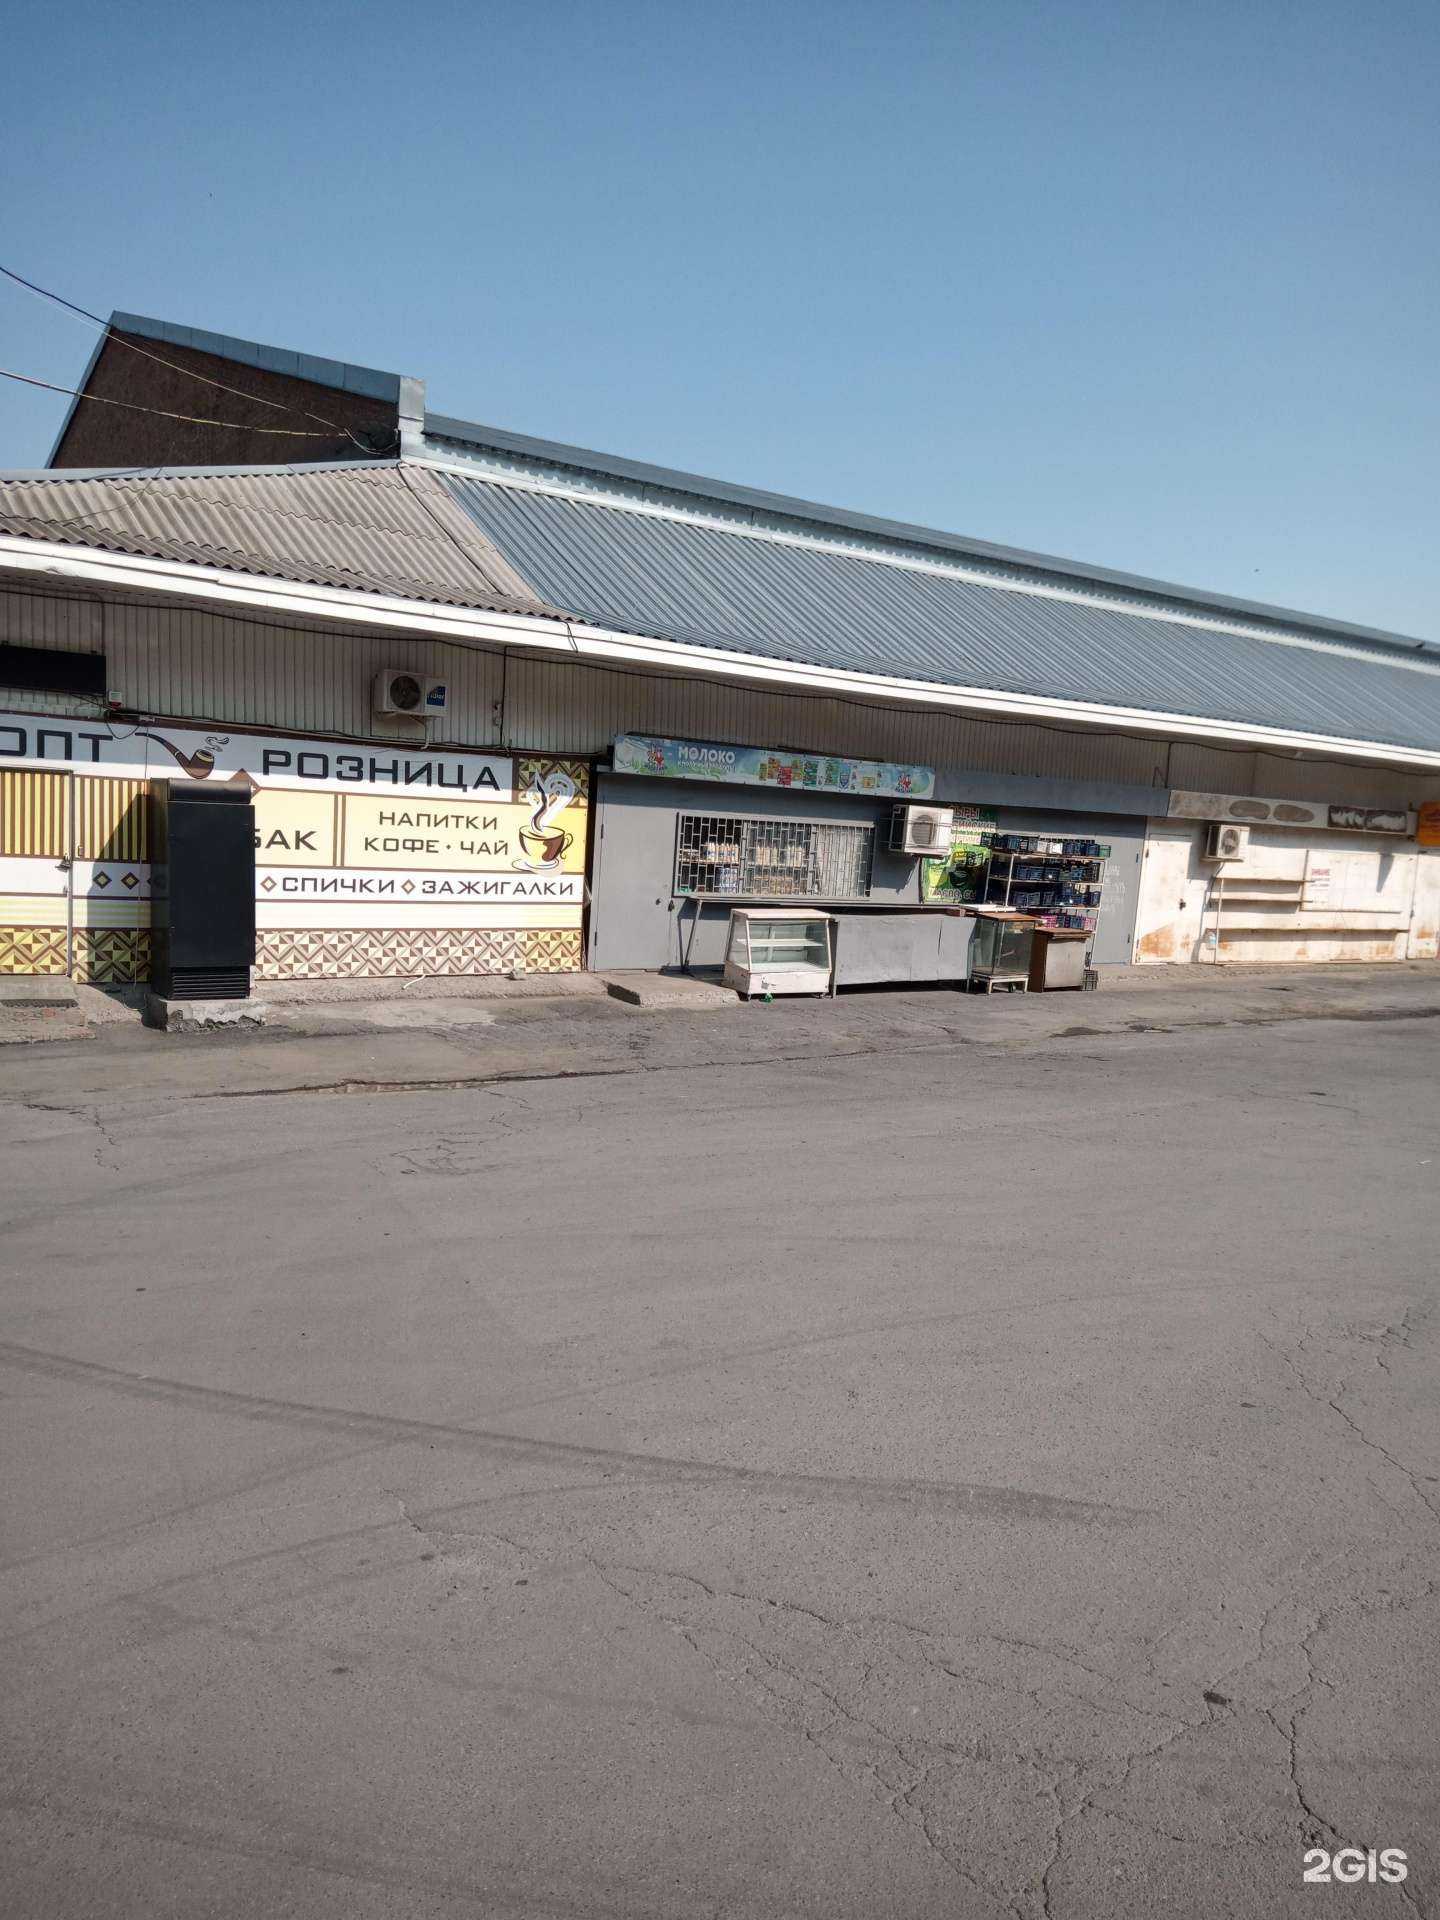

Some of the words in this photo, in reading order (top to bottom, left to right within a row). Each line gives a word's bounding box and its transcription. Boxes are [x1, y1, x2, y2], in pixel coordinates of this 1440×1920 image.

[0, 726, 114, 763] ОПТ
[262, 749, 502, 792] РОЗНИЦА
[678, 746, 736, 764] МОЛОКО
[379, 810, 498, 831] НАПИТКИ
[949, 806, 980, 819] ЫРЫ
[364, 836, 440, 856] КОФЕ
[462, 839, 510, 857] ЧАЙ
[282, 875, 396, 894] СПИЧКИ
[421, 879, 574, 896] ЗАЖИГАЛКИ
